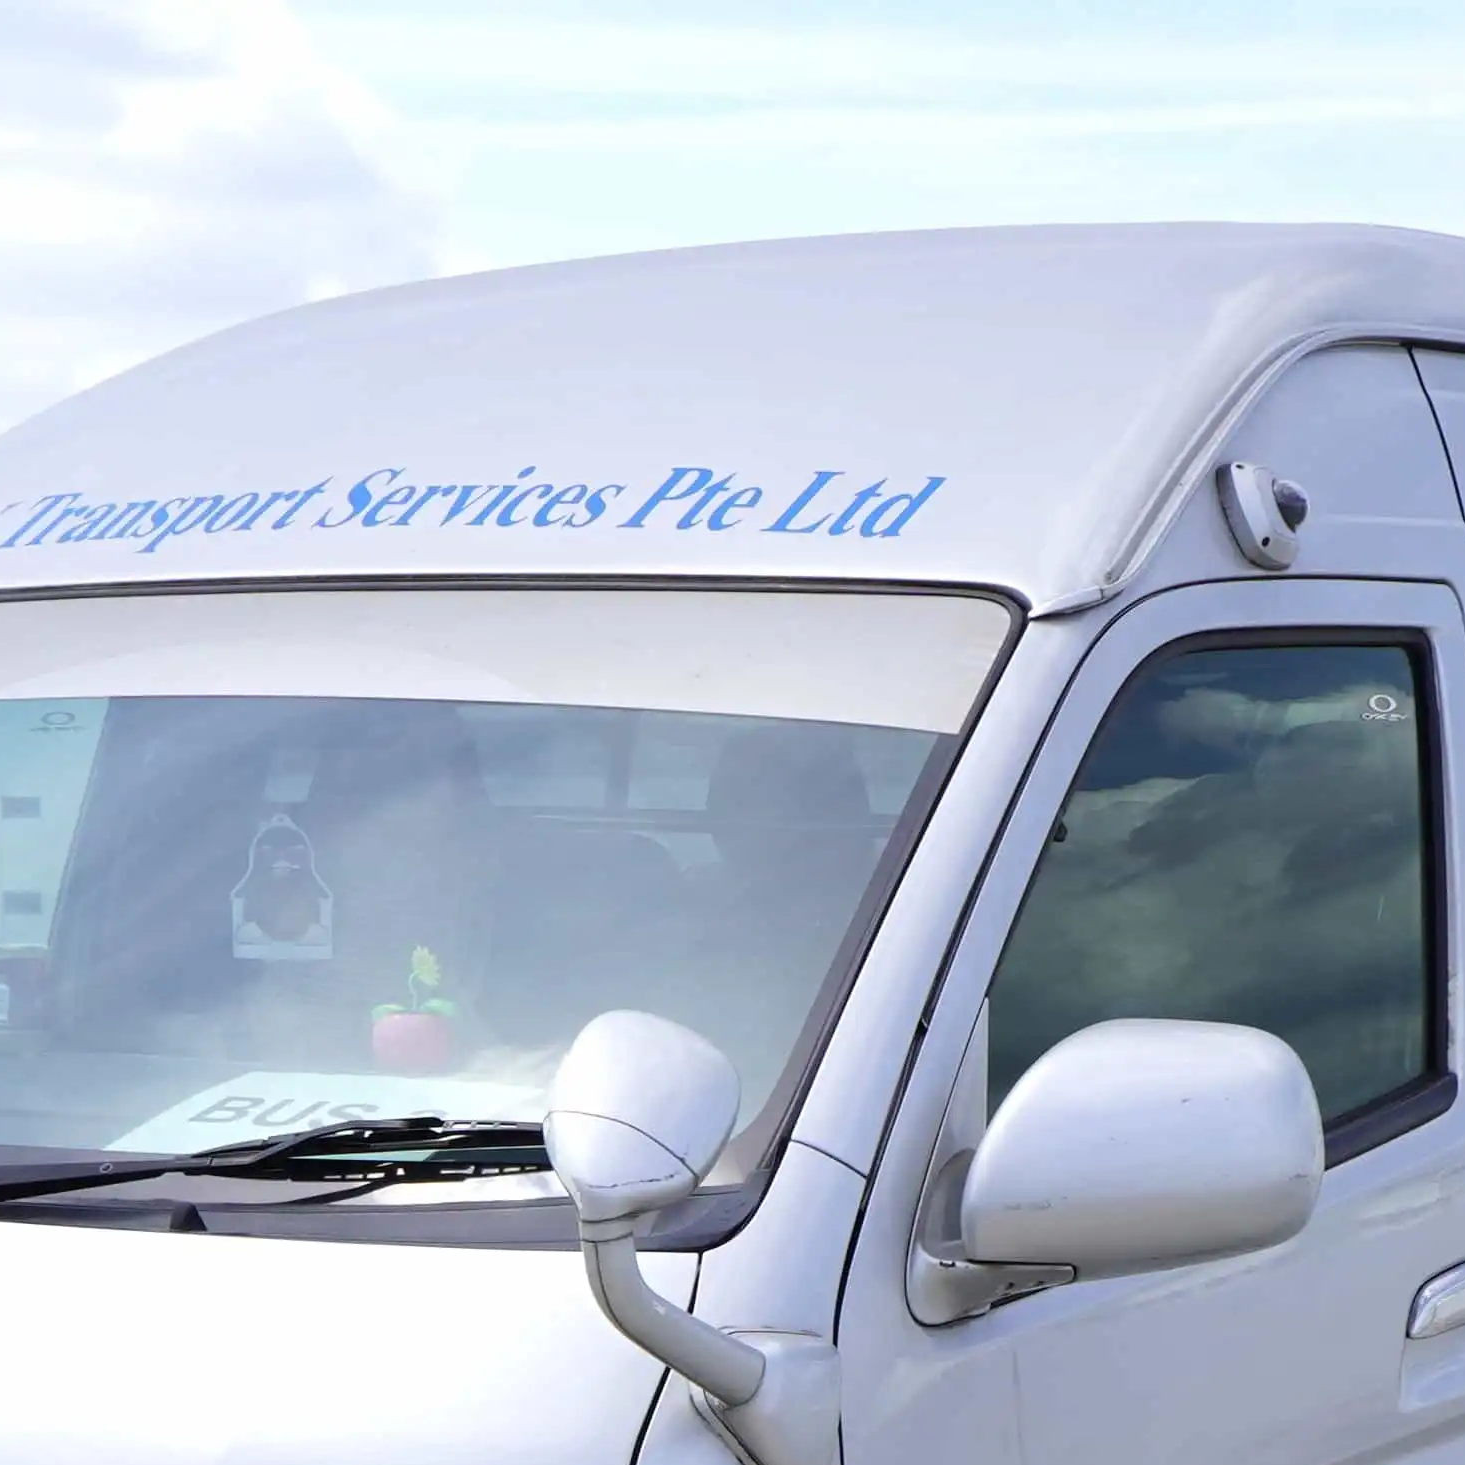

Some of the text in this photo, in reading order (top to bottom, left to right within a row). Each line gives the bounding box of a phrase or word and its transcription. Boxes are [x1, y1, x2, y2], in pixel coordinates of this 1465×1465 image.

[311, 465, 627, 529] Services
[617, 467, 763, 531] Pte
[760, 471, 947, 538] Ltd
